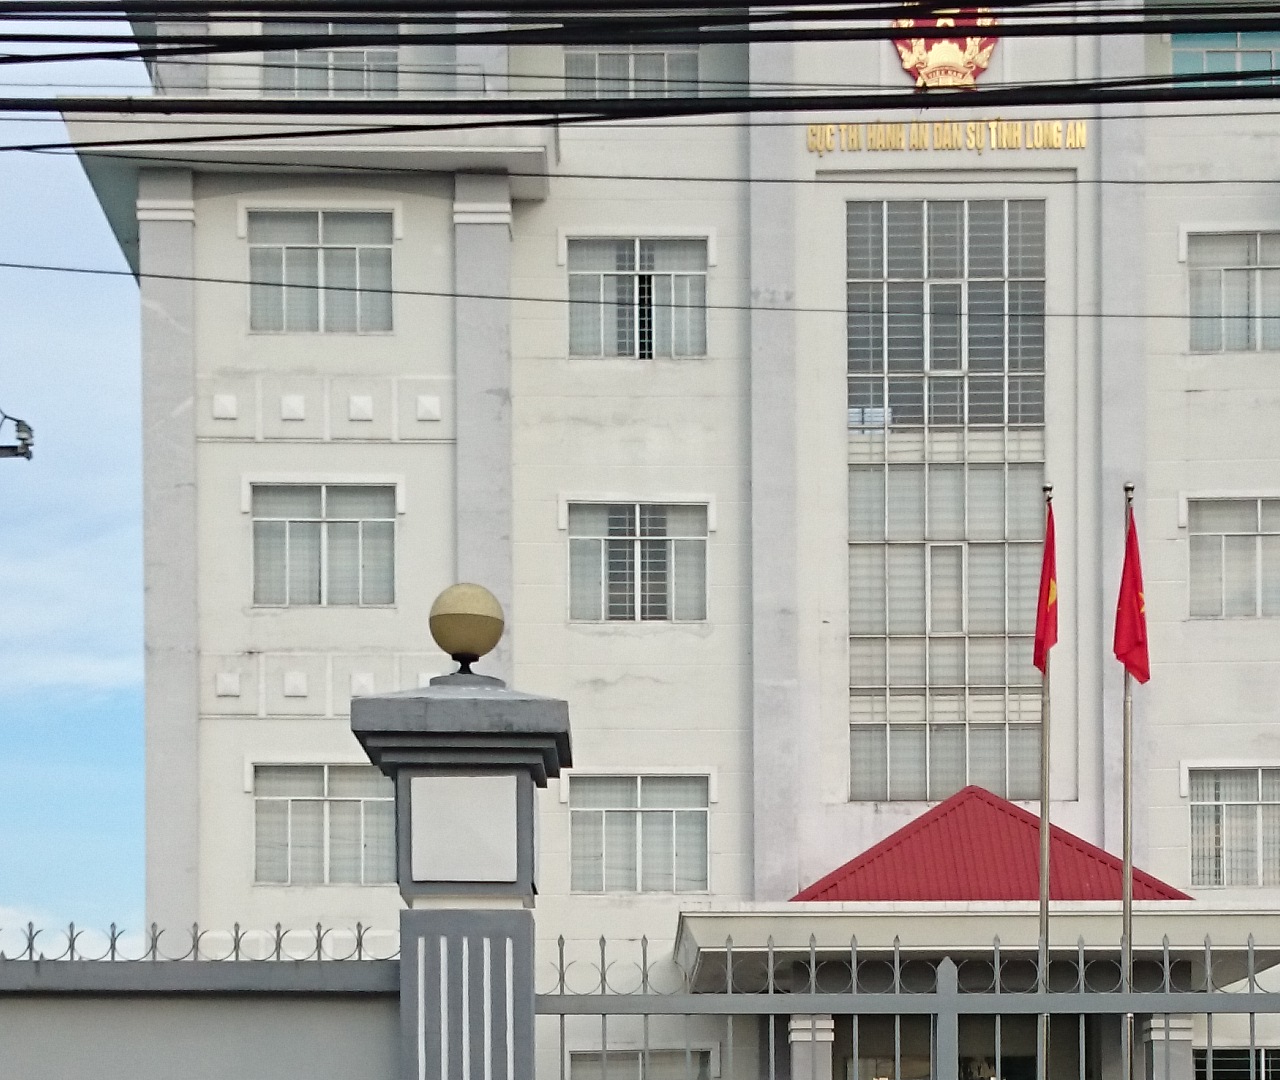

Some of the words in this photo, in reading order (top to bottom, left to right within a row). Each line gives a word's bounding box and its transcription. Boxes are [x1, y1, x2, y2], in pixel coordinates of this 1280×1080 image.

[808, 123, 835, 157] CỤC
[839, 124, 861, 151] THI
[1025, 121, 1062, 149] LONG
[1065, 120, 1087, 149] AN
